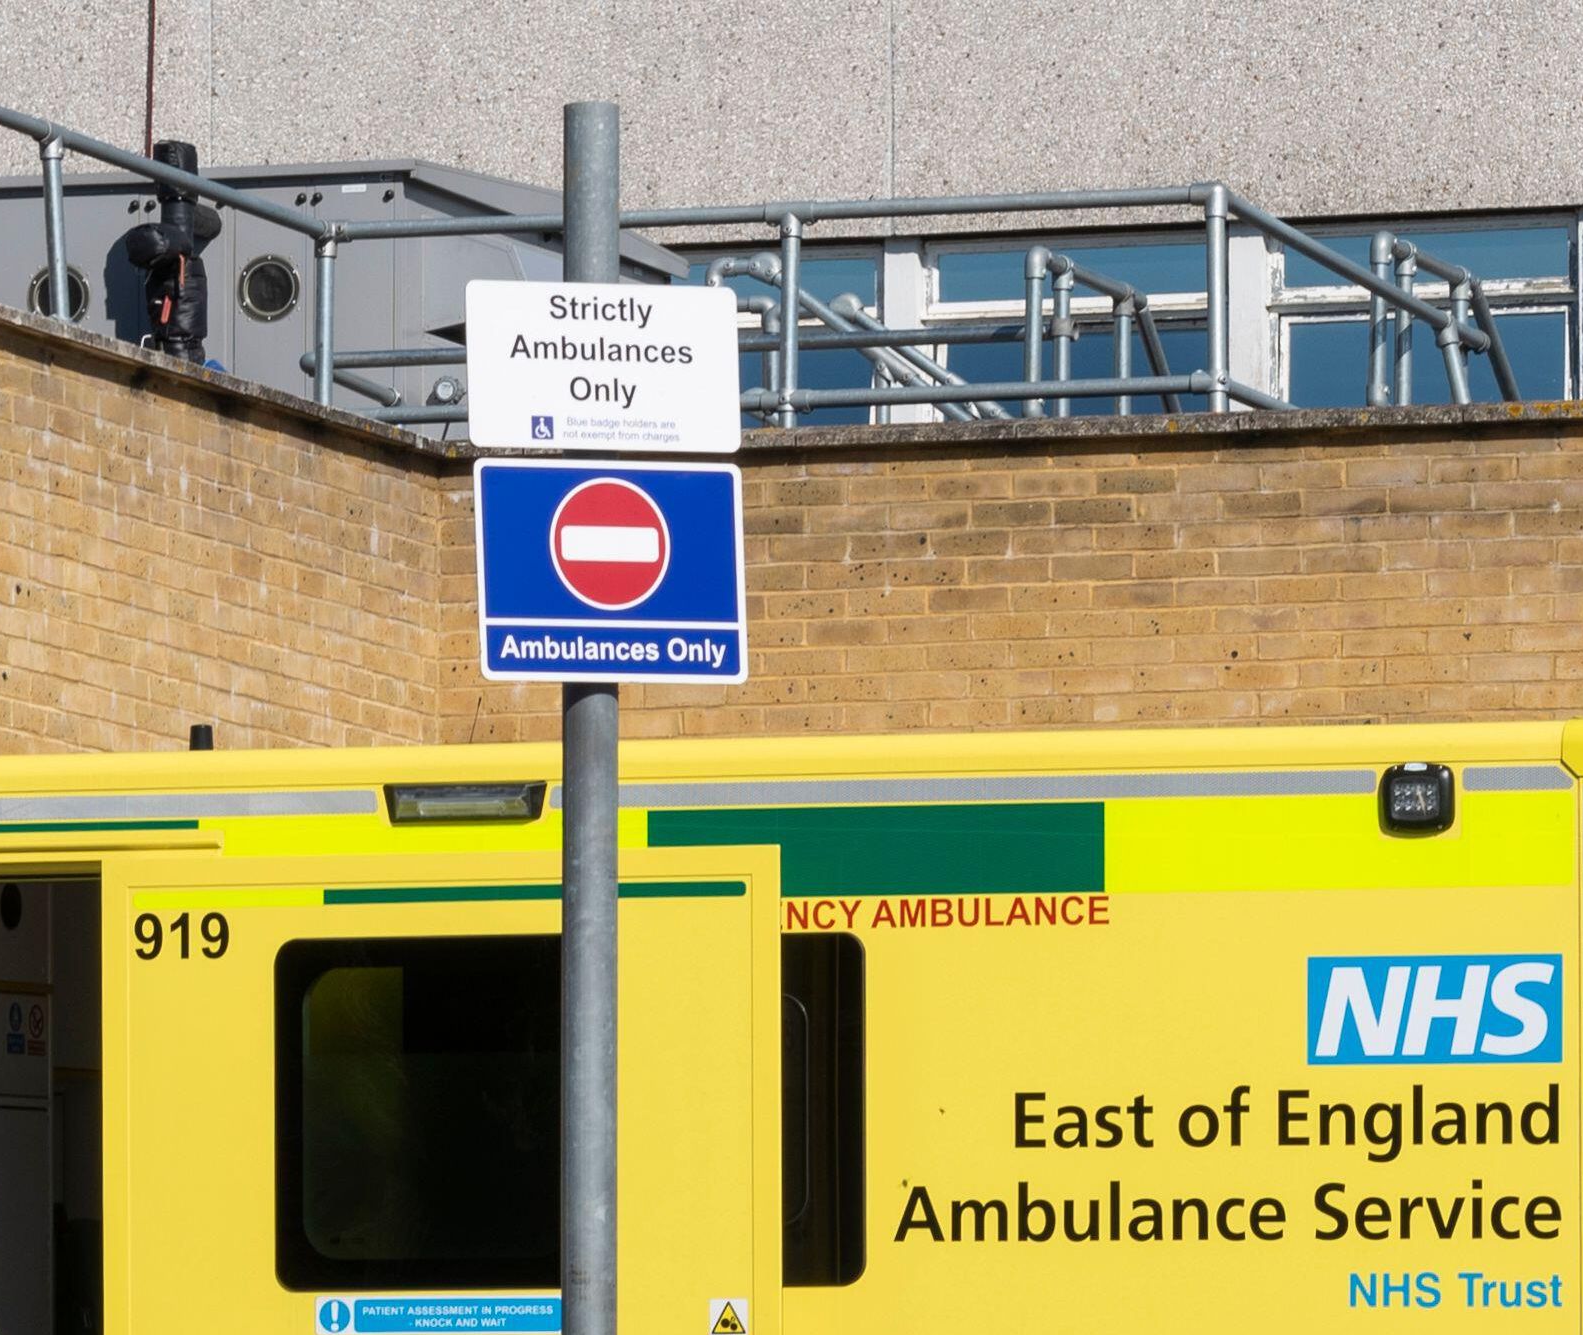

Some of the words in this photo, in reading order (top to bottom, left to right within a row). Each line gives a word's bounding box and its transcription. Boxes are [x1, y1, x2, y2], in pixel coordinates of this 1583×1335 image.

[549, 294, 653, 328] Strictly
[509, 334, 693, 364] Ambulances
[569, 376, 637, 409] Only
[563, 430, 578, 439] not
[580, 431, 616, 442] exempt
[618, 430, 640, 441] from
[642, 432, 680, 444] charges
[566, 416, 588, 427] Blue
[590, 417, 620, 430] badge
[622, 418, 658, 429] holders
[660, 421, 676, 430] are
[500, 634, 660, 662] Ambulances
[667, 637, 726, 668] Only
[870, 895, 1111, 930] AMBULANCE
[133, 910, 231, 961] 919
[1315, 961, 1556, 1059] NHS
[1015, 1090, 1154, 1150] East
[1177, 1085, 1250, 1149] of
[1277, 1083, 1561, 1163] England
[893, 1180, 1287, 1243] Ambulance
[1314, 1180, 1563, 1241] Service
[1349, 1273, 1442, 1309] NHS
[1458, 1272, 1563, 1309] Trust
[362, 1306, 404, 1316] PATIENT
[407, 1305, 478, 1316] ASSESSMENT
[481, 1305, 492, 1315] IN
[494, 1304, 553, 1315] PROGRESS
[414, 1318, 452, 1328] KNOCK
[455, 1317, 478, 1327] AND
[480, 1317, 506, 1327] WAIT
